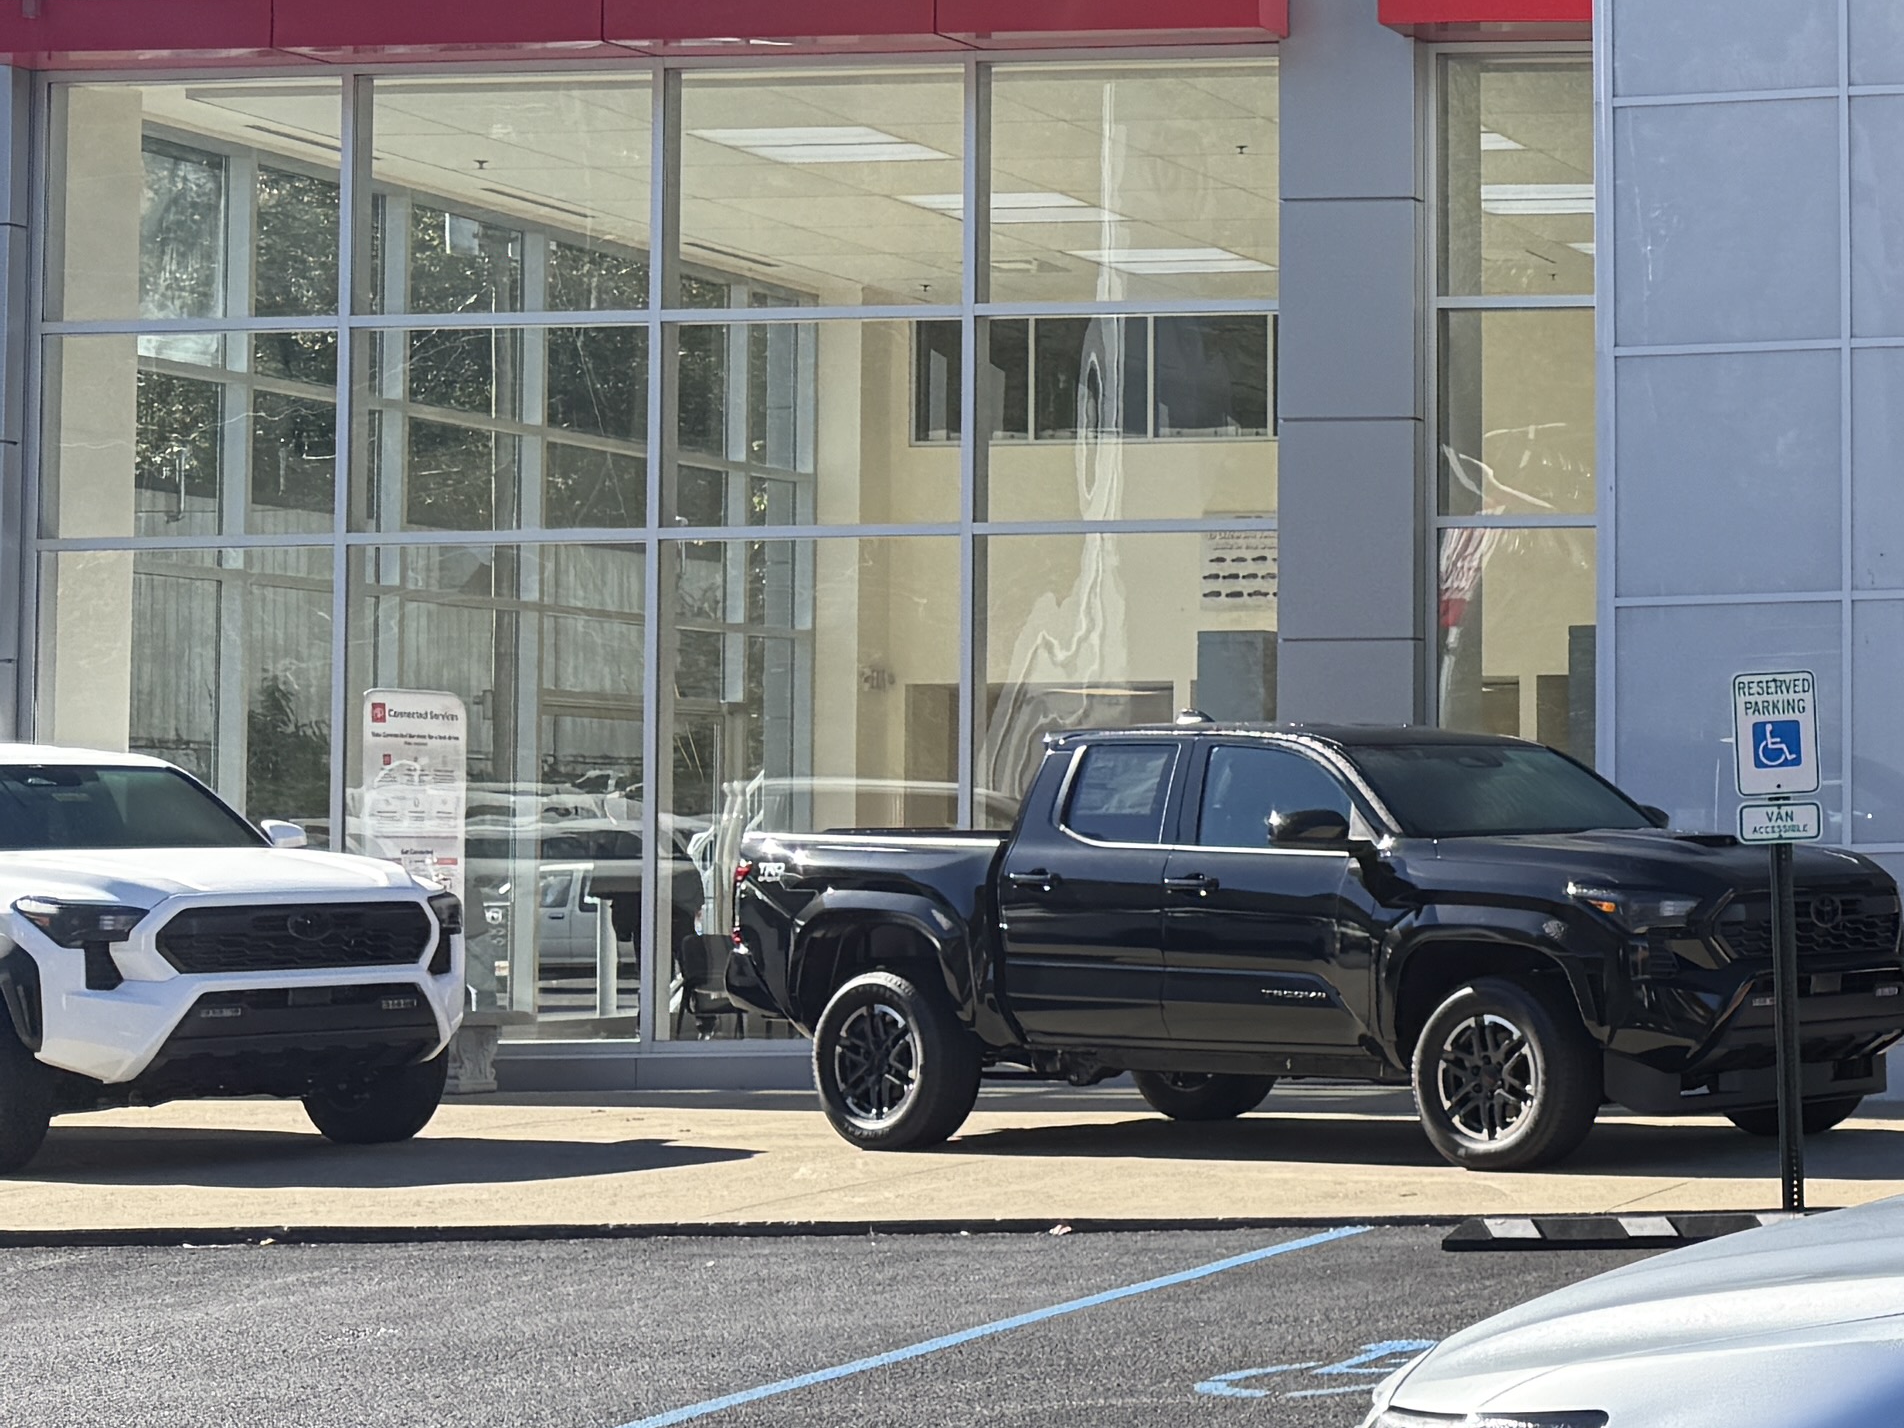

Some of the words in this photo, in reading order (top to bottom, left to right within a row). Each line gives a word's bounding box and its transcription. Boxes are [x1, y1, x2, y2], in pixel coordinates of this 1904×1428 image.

[1737, 678, 1811, 698] RESERVED
[388, 708, 428, 720] Connected
[429, 711, 459, 721] Services
[1744, 698, 1807, 717] PARKING
[1765, 809, 1795, 823] VAN
[1752, 823, 1809, 835] ACCESSIBLE
